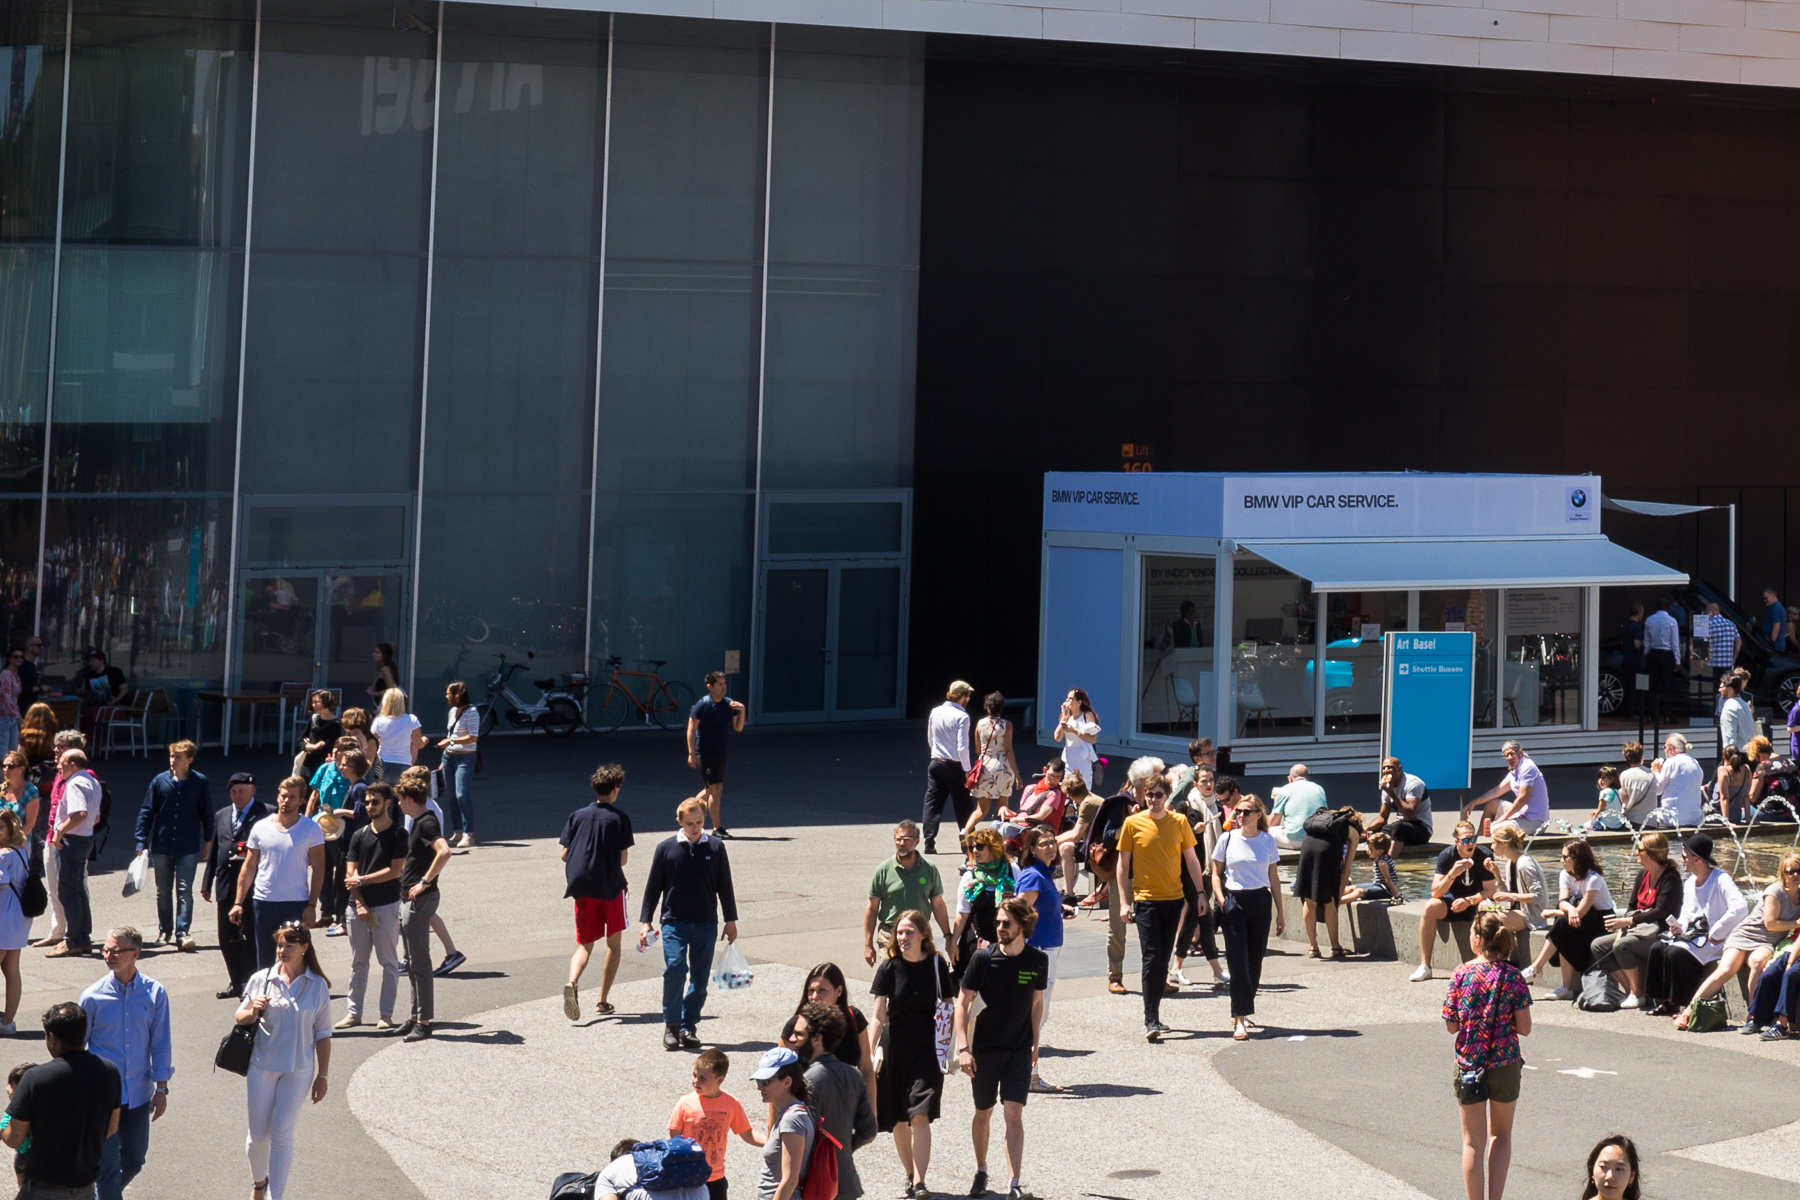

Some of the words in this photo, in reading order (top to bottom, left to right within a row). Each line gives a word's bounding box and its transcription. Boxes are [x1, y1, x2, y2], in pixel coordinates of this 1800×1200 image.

[1051, 490, 1073, 504] BMW
[1073, 491, 1086, 504] VIP
[1086, 491, 1104, 504] CAR
[1104, 491, 1140, 505] SERVICE.
[1243, 495, 1280, 509] BMW
[1281, 495, 1304, 509] VIP
[1306, 495, 1336, 509] CAR
[1337, 494, 1399, 508] SERVICE.
[1165, 567, 1216, 578] INDEPENDE
[1396, 638, 1410, 650] Art
[1413, 638, 1436, 650] Basel
[1412, 665, 1437, 673] Shuttle
[1438, 665, 1463, 673] Busses
